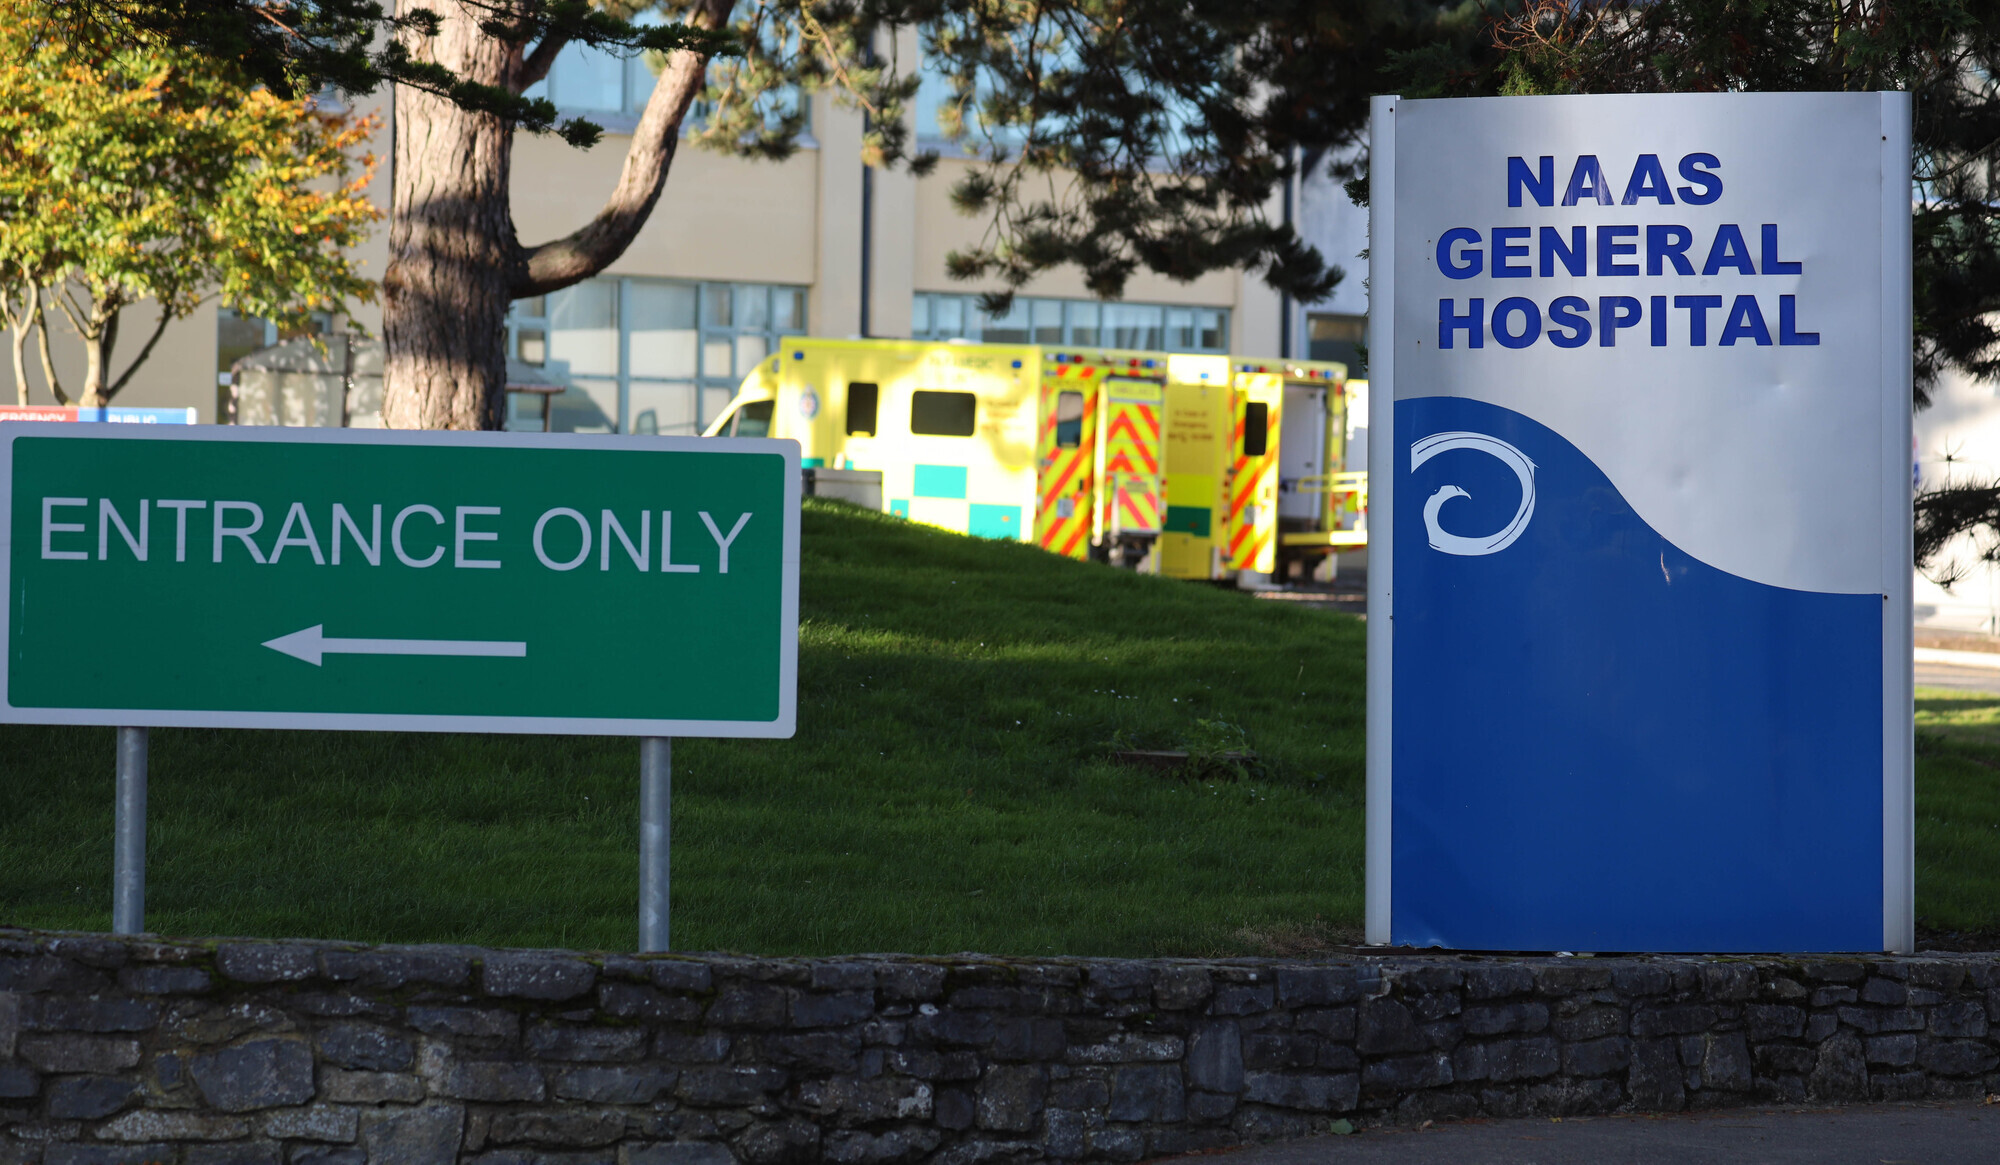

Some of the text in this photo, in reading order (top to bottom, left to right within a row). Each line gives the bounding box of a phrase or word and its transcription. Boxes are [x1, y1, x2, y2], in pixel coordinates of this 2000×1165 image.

[1507, 153, 1724, 208] NAAS
[1436, 224, 1803, 280] GENERAL
[1438, 294, 1821, 350] HOSPITAL
[41, 497, 753, 574] ENTRANCE ONLY
